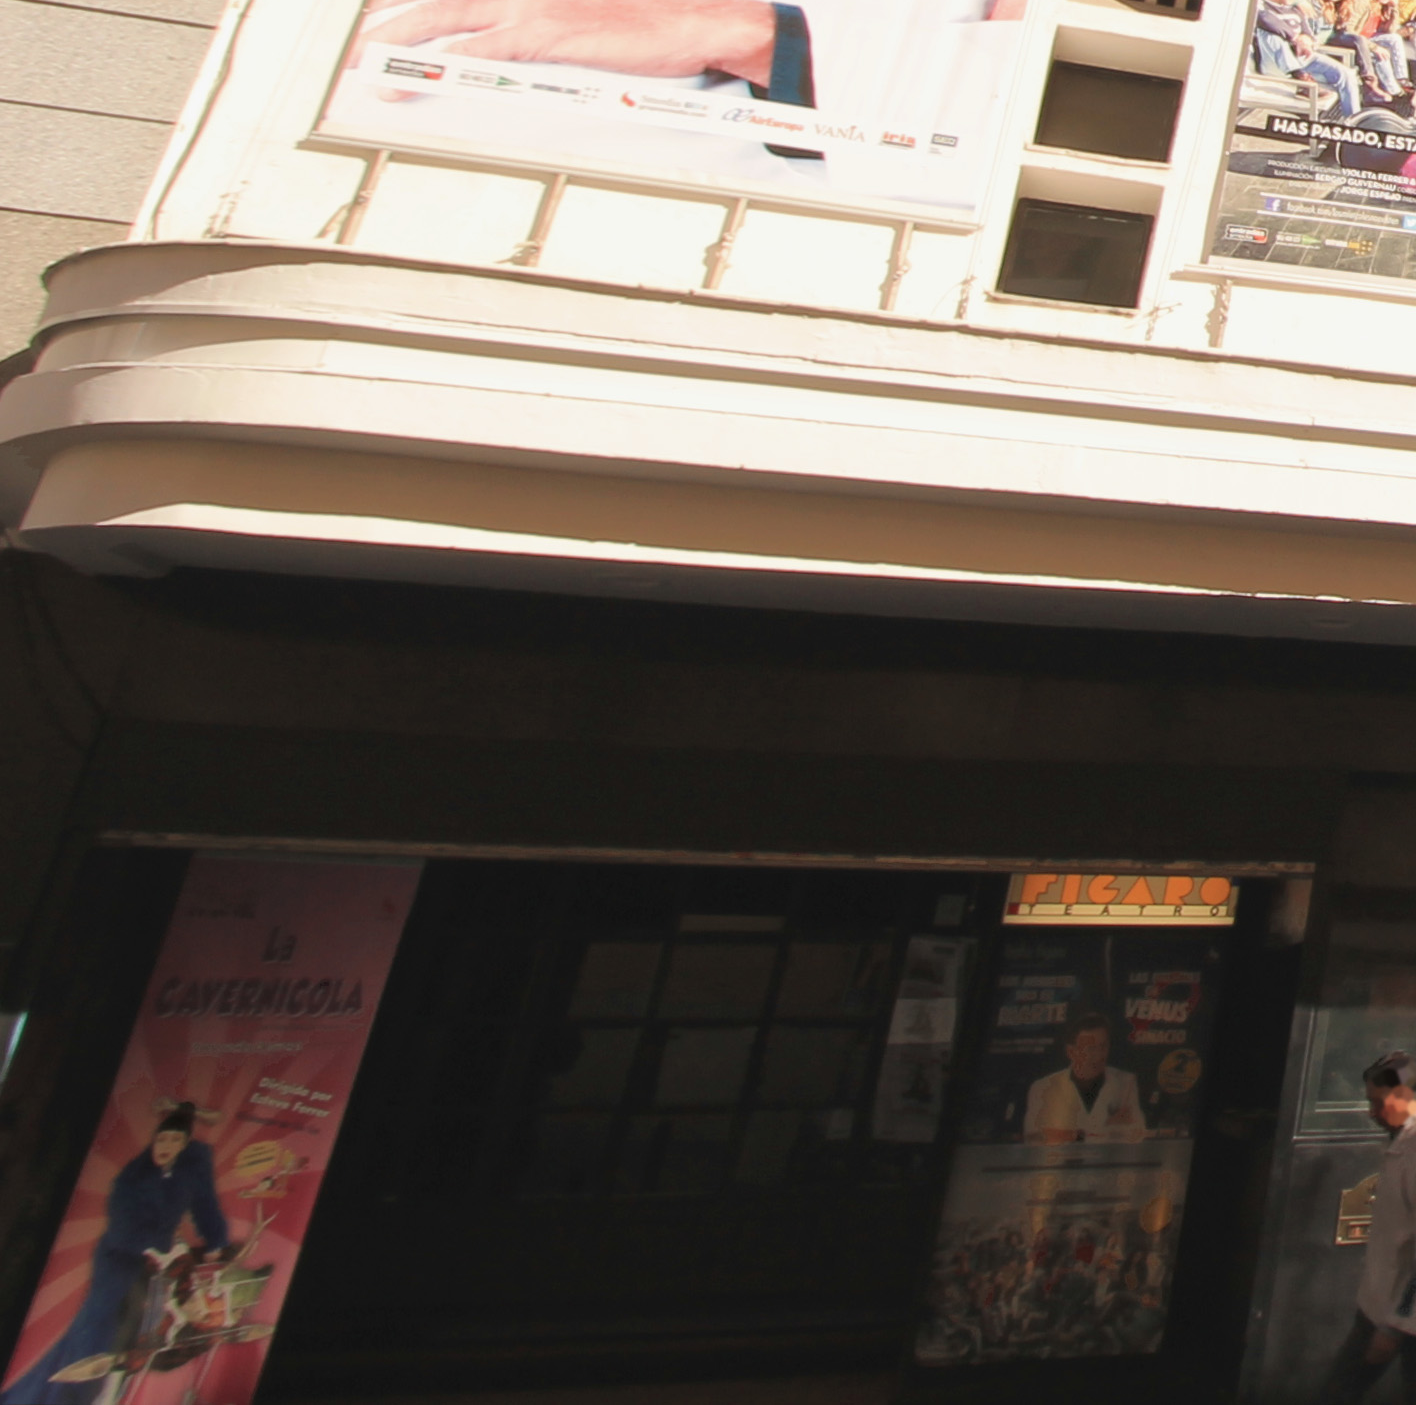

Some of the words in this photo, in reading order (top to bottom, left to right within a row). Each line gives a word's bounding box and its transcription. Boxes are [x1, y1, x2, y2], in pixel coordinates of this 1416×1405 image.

[1272, 118, 1309, 137] HAS
[1311, 123, 1383, 149] PASADO,
[1020, 874, 1231, 905] FIGARO
